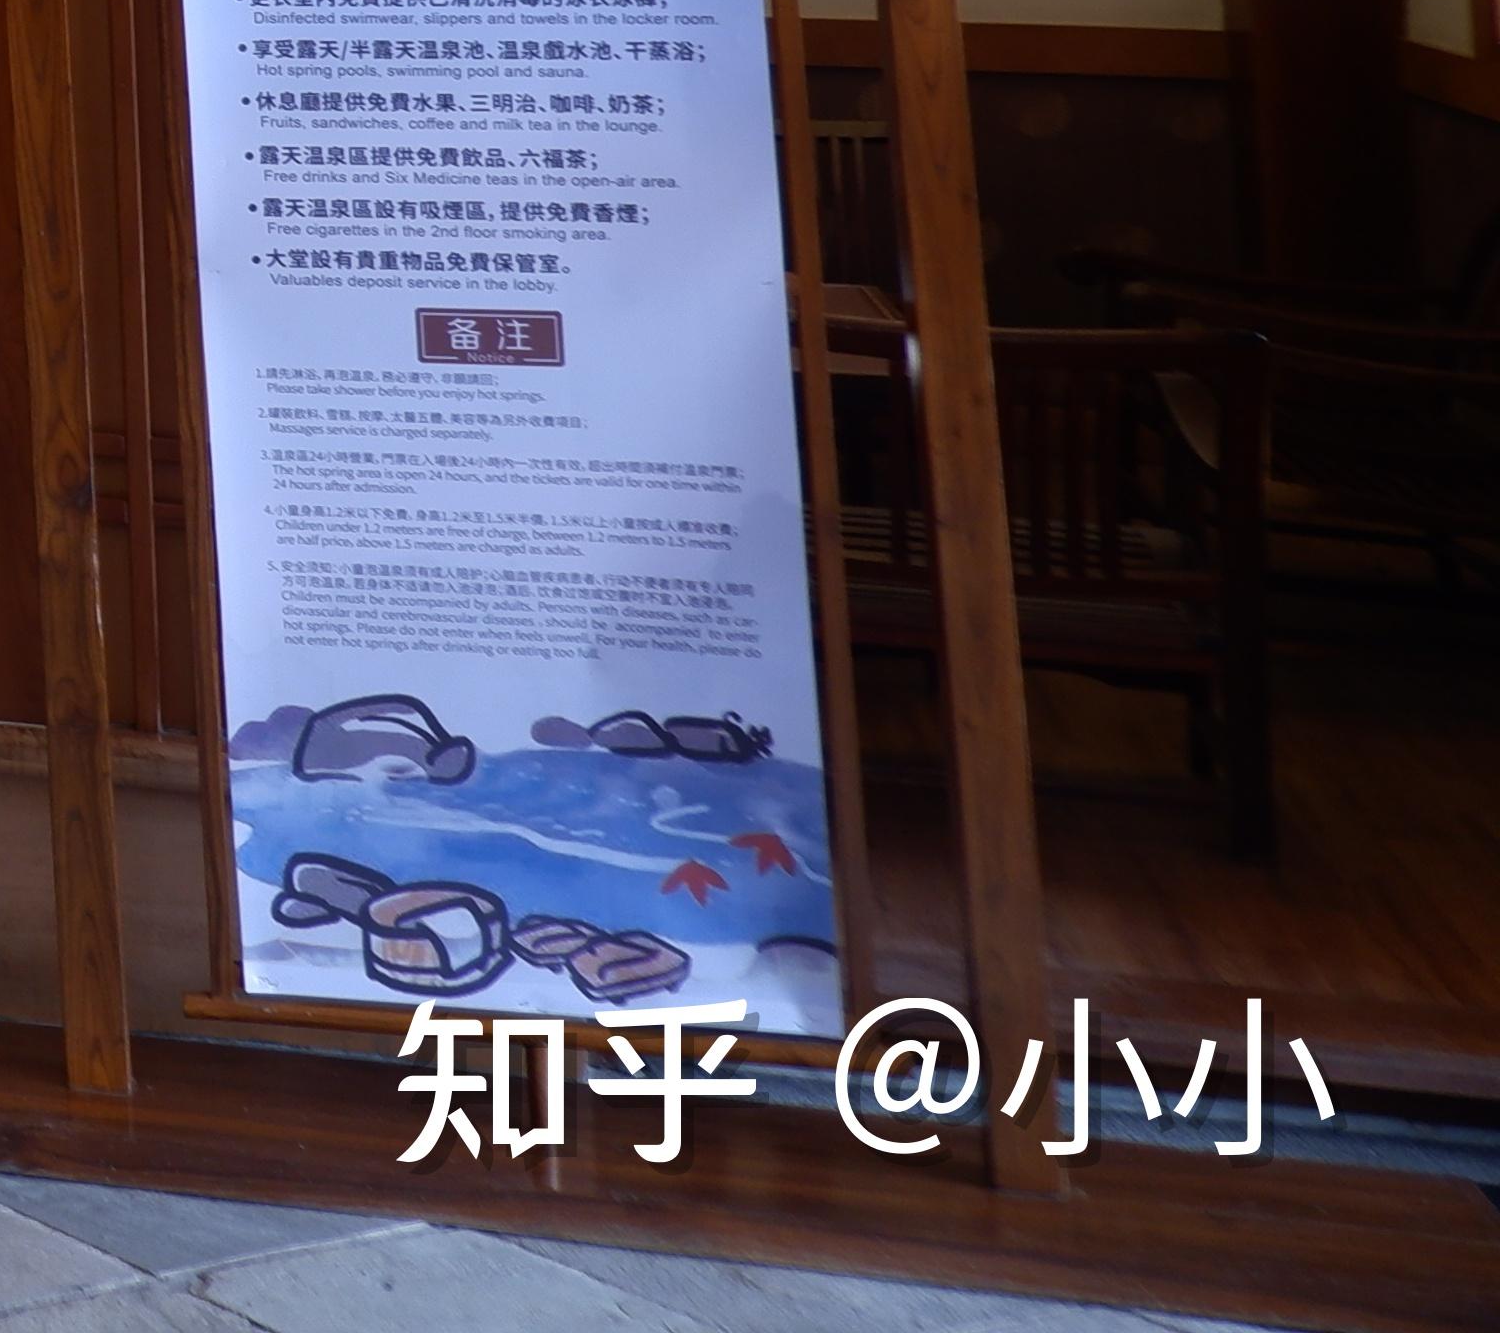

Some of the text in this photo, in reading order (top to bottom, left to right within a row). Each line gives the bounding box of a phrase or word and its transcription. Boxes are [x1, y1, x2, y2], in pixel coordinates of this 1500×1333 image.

[253, 12, 719, 27] Disinfected swimwear, slippers and towels in the locker room.
[256, 64, 588, 81] Hot spring pools, swimming pool and sauna.
[260, 117, 661, 135] Fruits, sandwiches, coffee and milk tea in the lounge.
[263, 170, 680, 190] Free drinks and Six Medicine teas in the open-air area.
[267, 223, 613, 242] Free cigarettes in the 2nd floor smoking area.
[270, 273, 558, 293] Valuables deposit service in the lobby.
[466, 351, 516, 363] Notice
